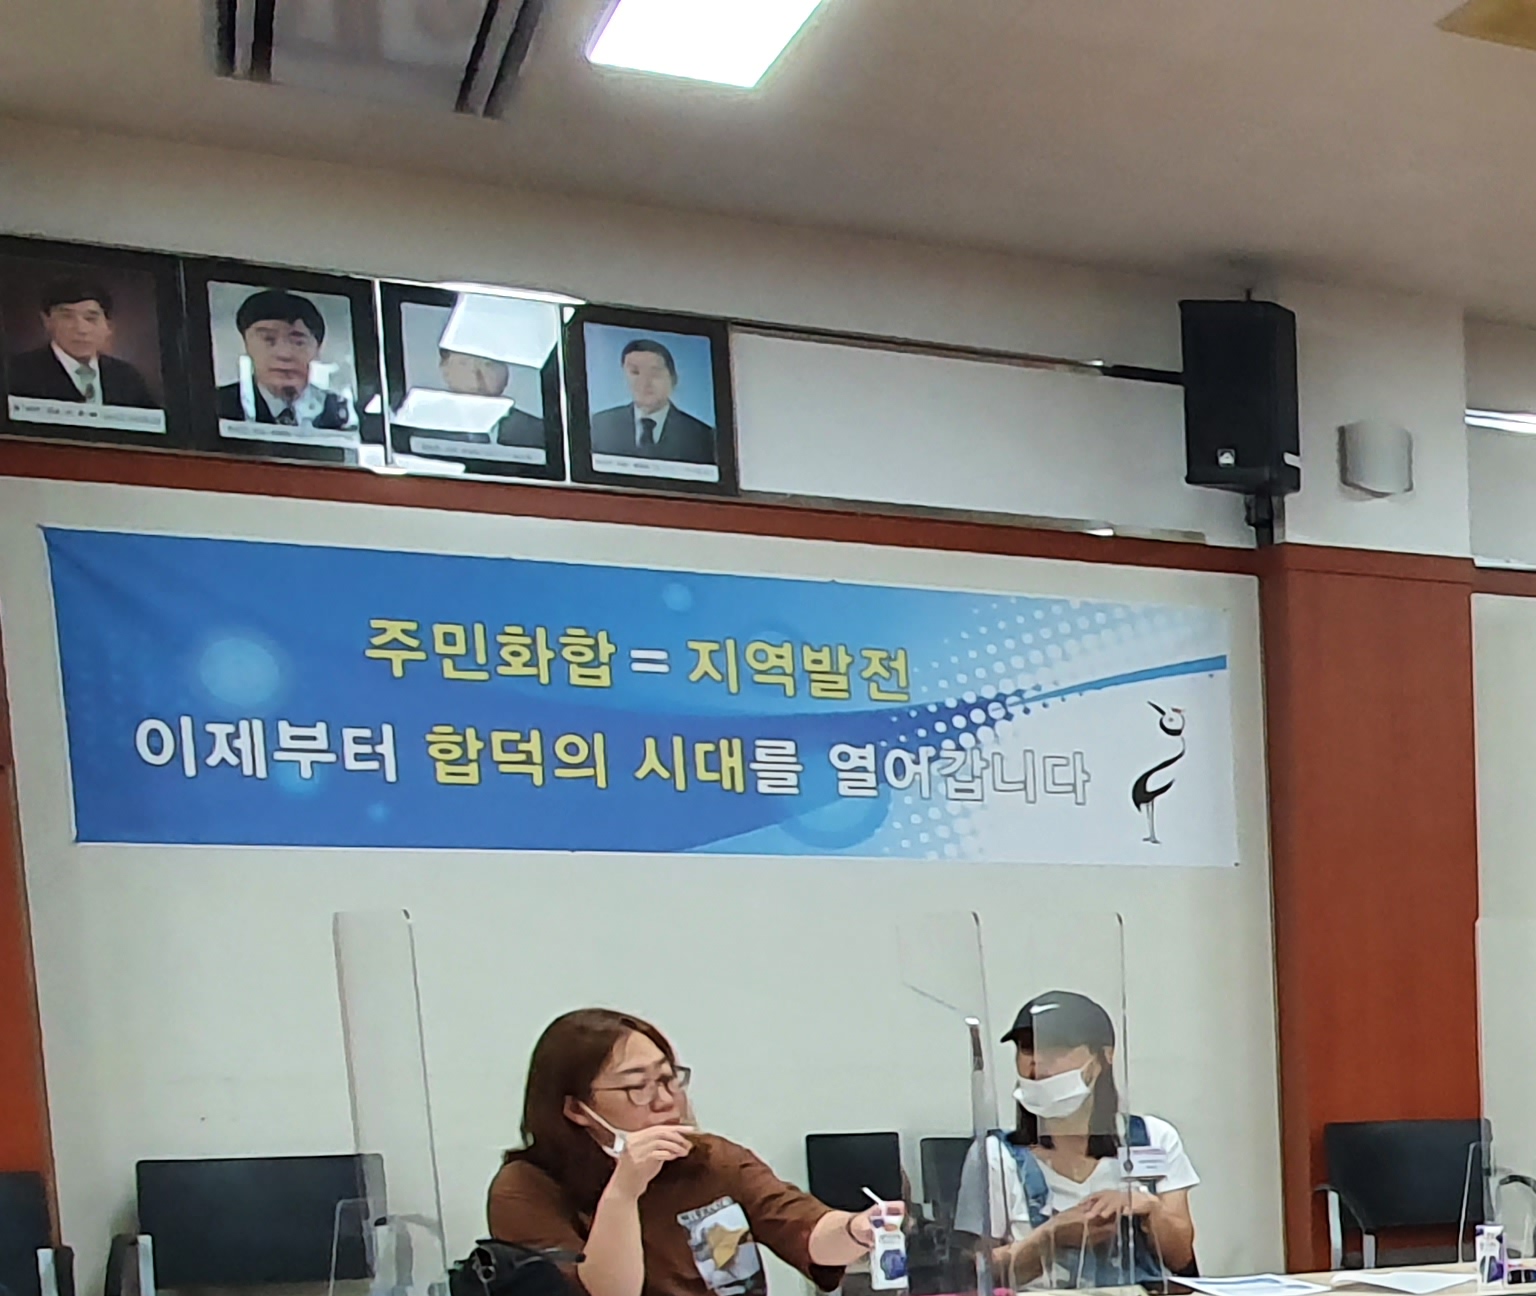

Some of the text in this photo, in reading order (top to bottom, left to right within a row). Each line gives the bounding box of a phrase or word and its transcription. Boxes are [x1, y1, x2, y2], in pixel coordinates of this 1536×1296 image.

[364, 618, 617, 688] 주민화합
[687, 638, 910, 701] 지역발전
[135, 714, 1091, 805] 이제부터 합덕의 시대를 열어갑니다
